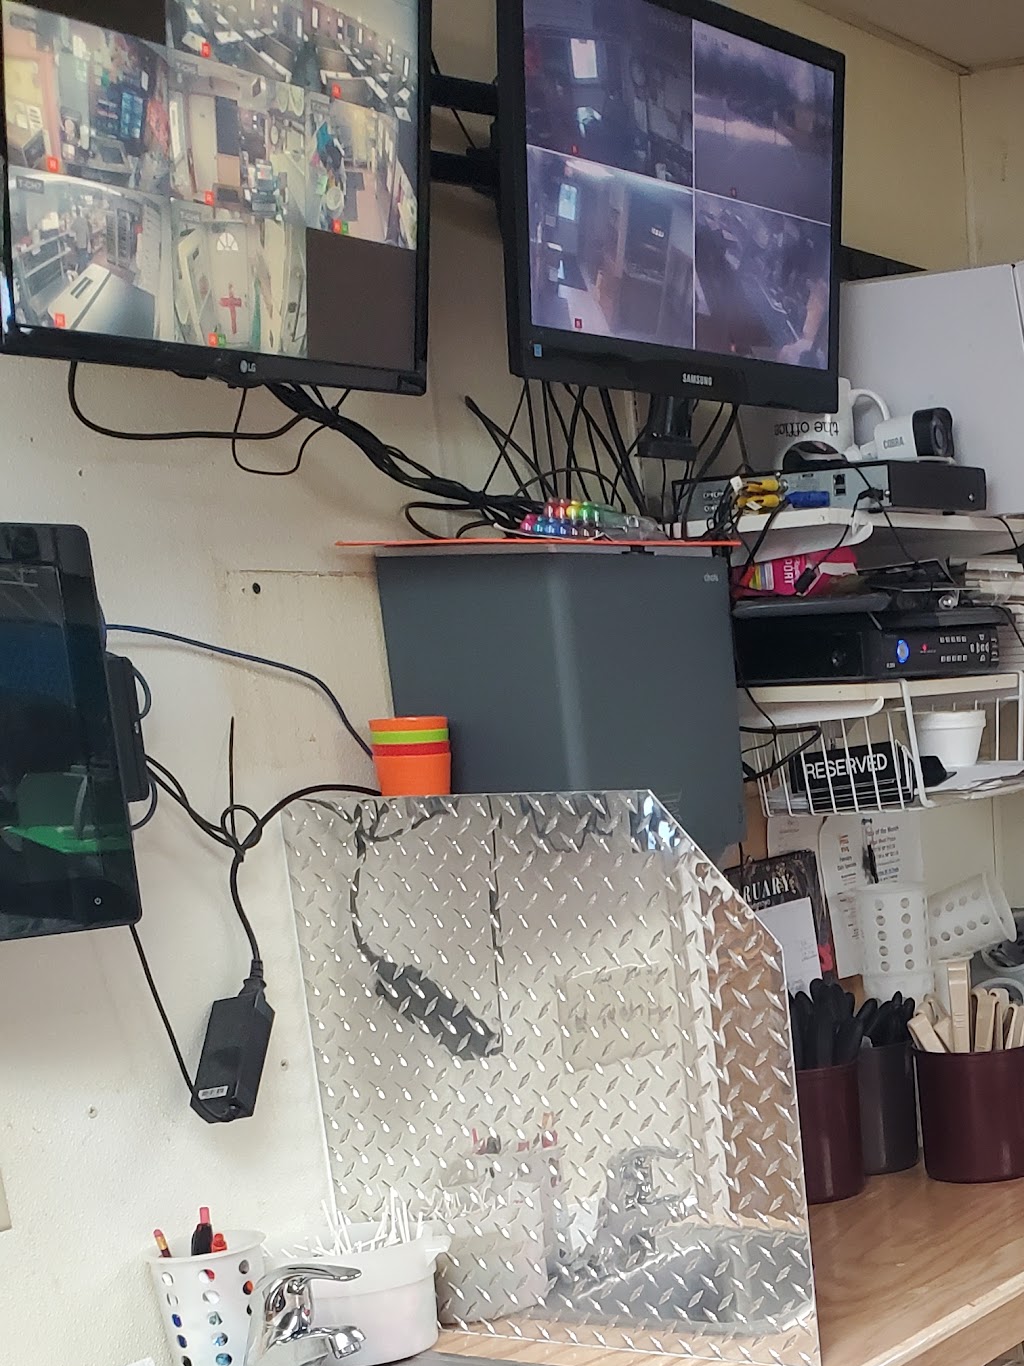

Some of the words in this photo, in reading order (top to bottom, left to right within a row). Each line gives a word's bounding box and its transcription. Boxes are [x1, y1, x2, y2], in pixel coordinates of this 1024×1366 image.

[682, 372, 713, 387] SAMSUNG
[804, 753, 888, 779] RESERVED
[739, 873, 790, 903] RUARY
